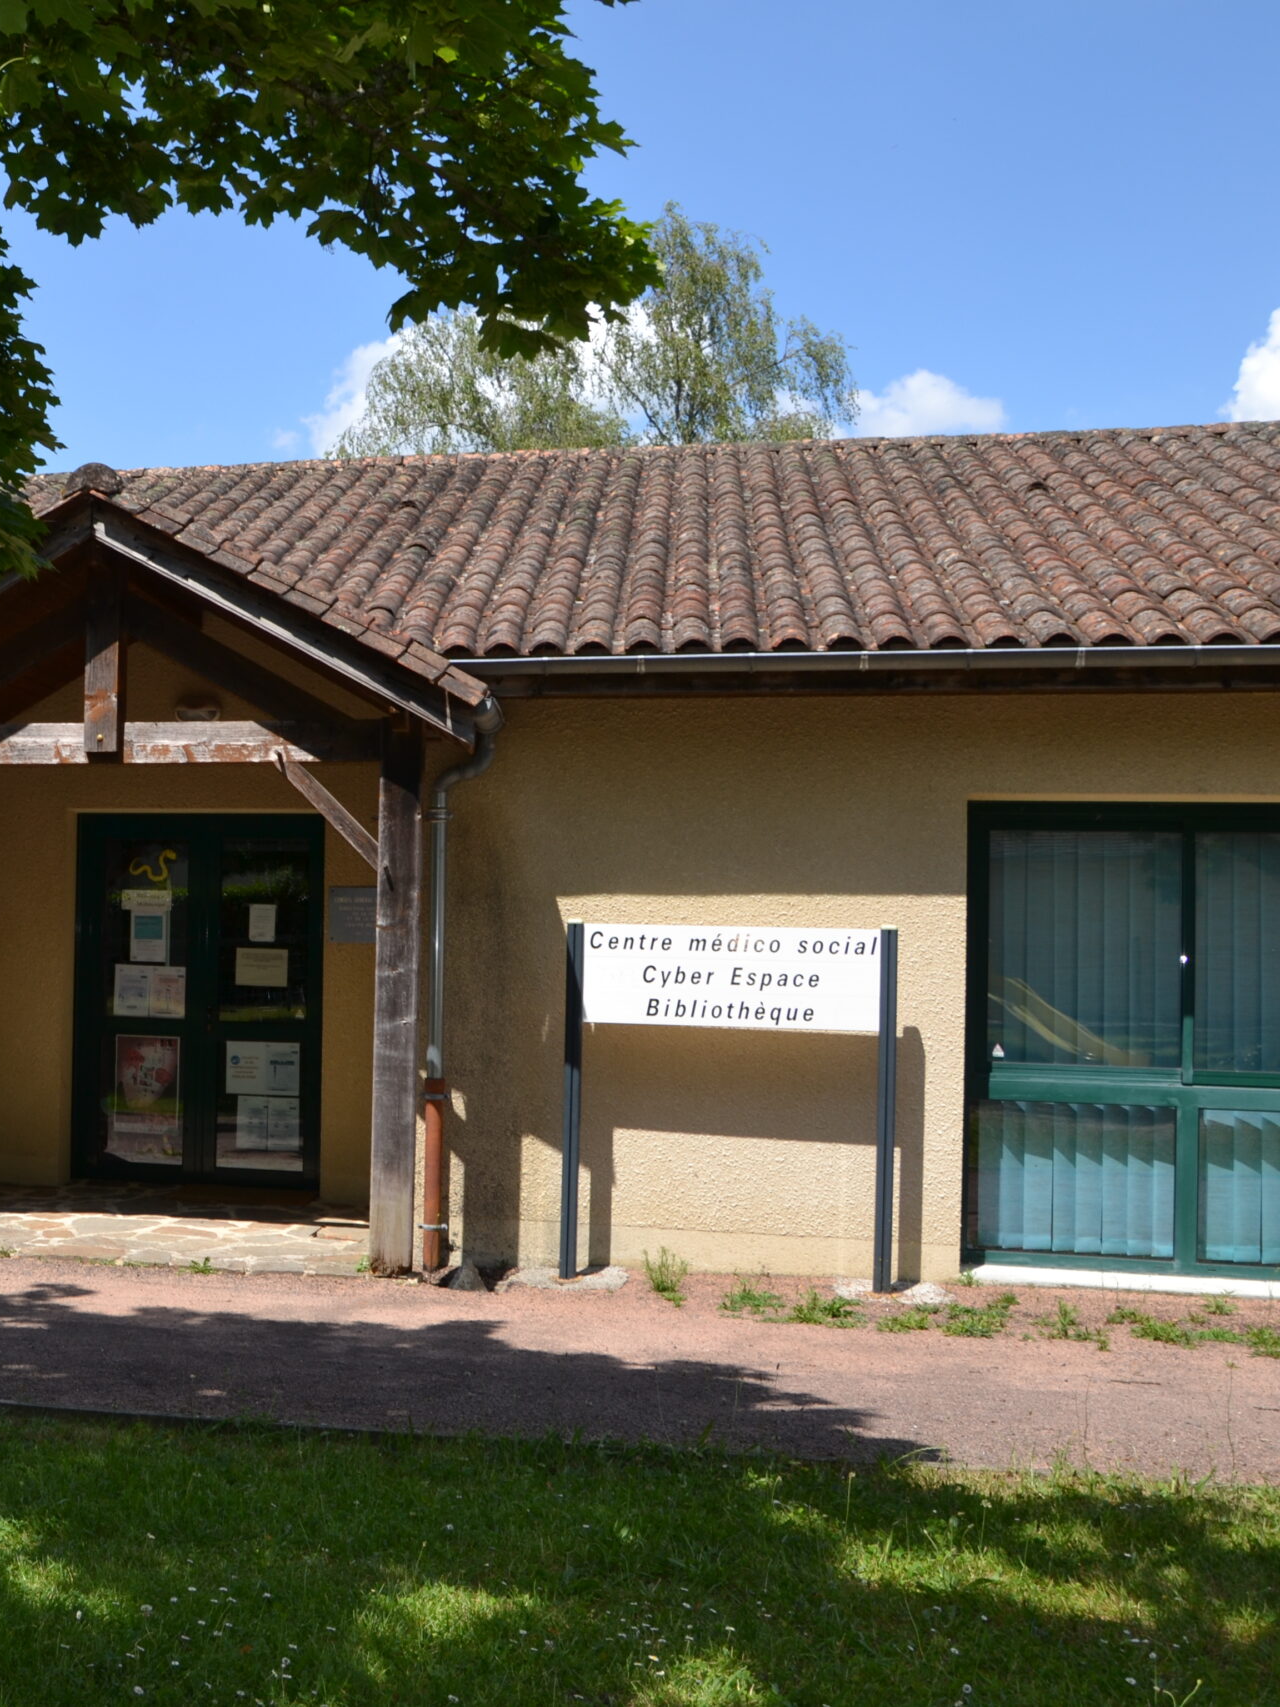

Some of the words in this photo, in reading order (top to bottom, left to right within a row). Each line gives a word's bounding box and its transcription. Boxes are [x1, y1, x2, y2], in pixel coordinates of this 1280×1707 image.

[589, 930, 673, 952] Centre
[688, 932, 781, 953] médico
[796, 936, 878, 956] social
[642, 965, 715, 988] Cyber
[730, 967, 821, 991] Espace
[646, 998, 815, 1026] Bibliothèque
